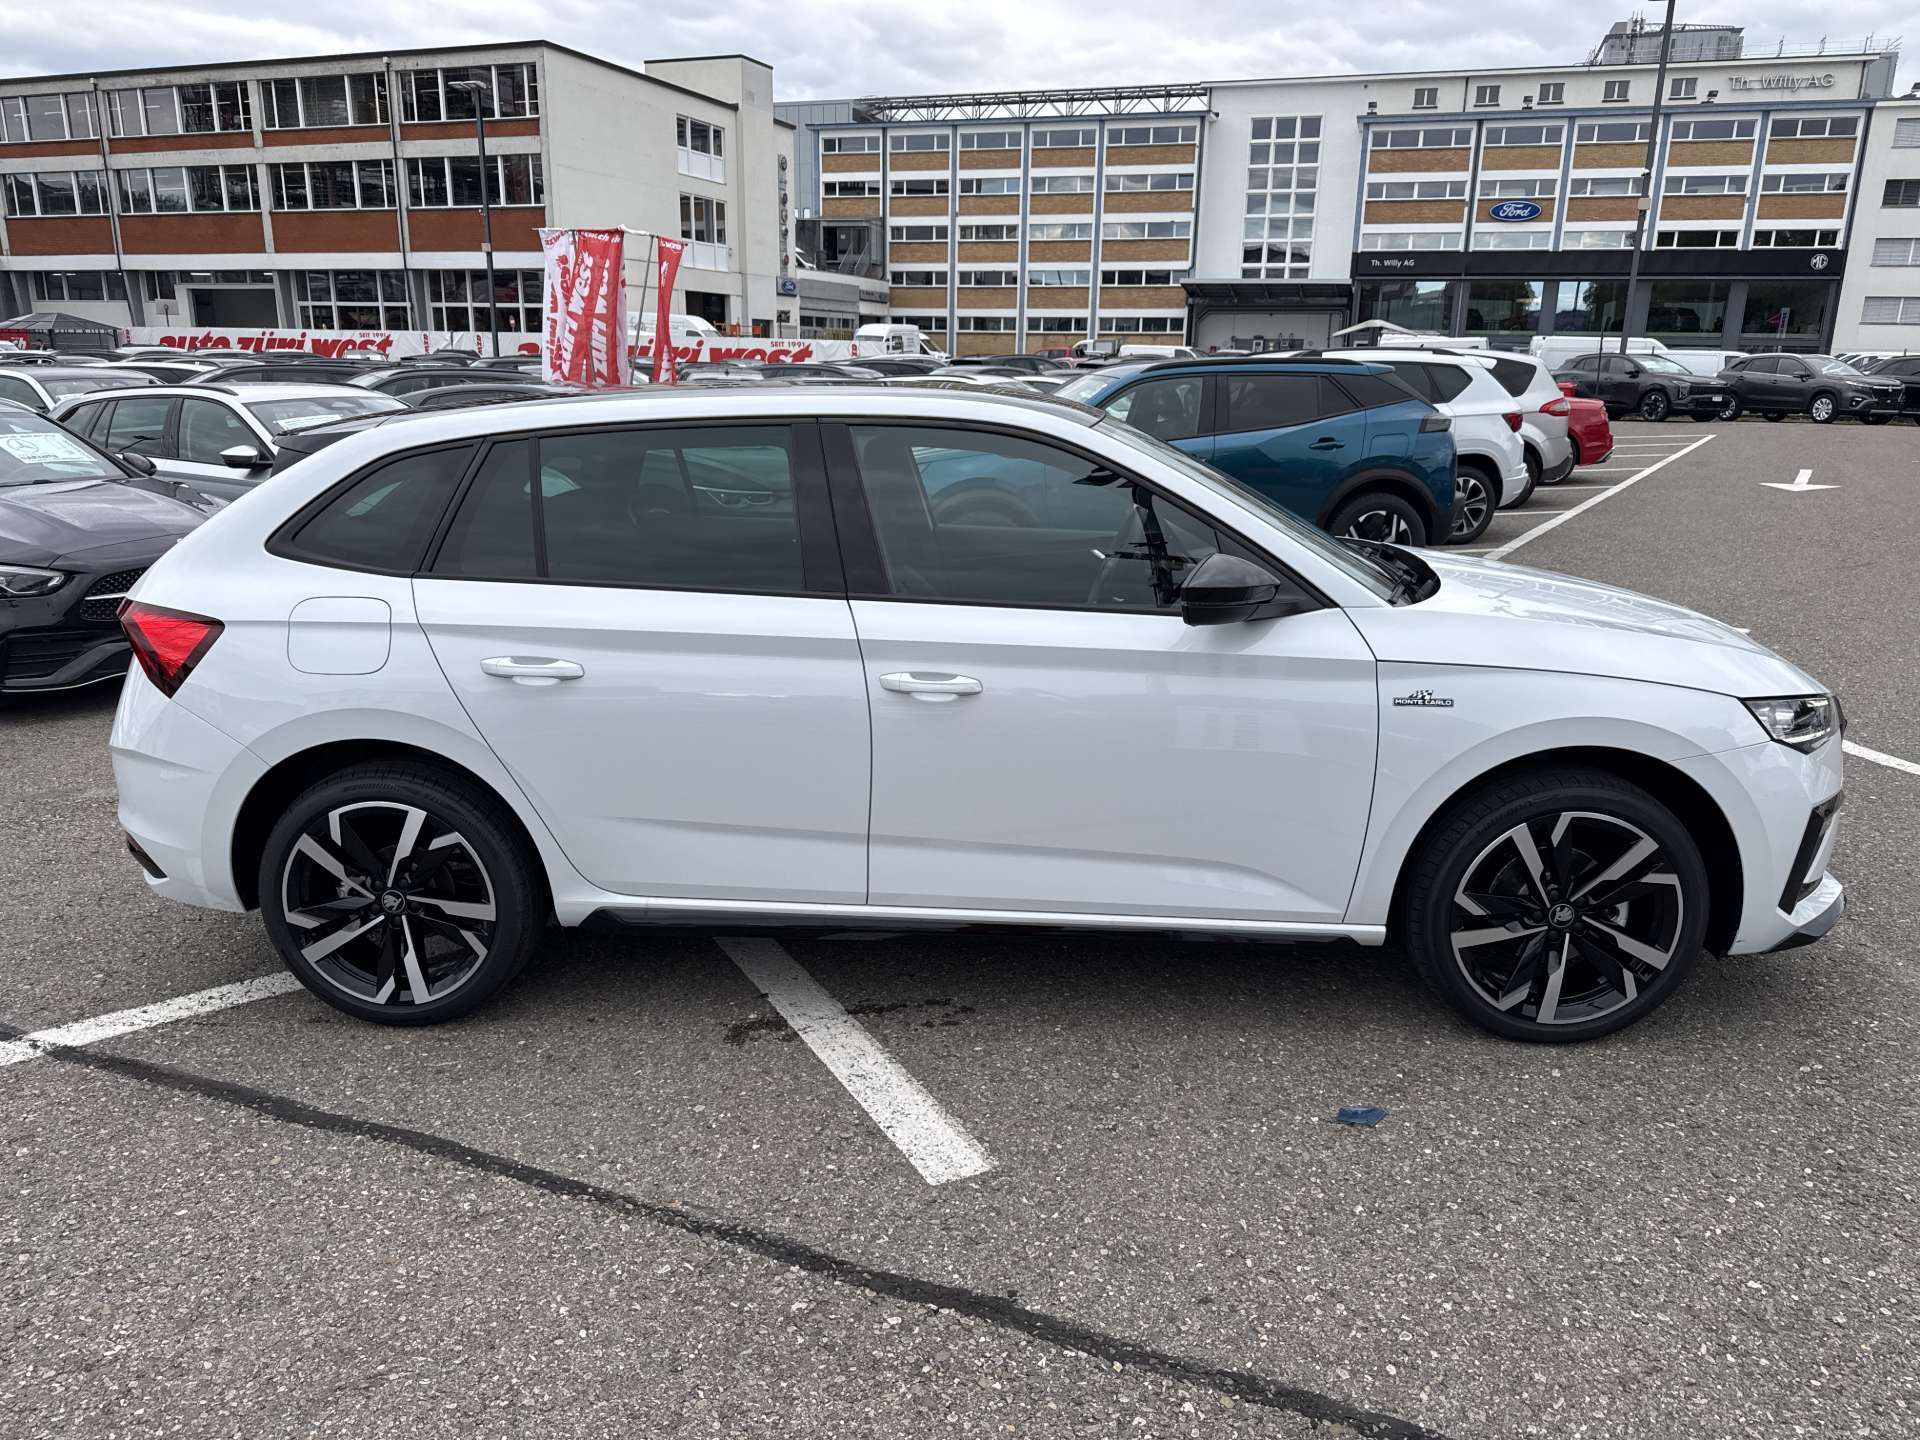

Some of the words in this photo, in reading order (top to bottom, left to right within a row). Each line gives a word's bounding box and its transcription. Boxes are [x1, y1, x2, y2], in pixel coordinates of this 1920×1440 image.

[1761, 73, 1802, 92] Willy
[1806, 73, 1835, 88] AG
[1499, 203, 1532, 217] Ford
[1371, 259, 1382, 267] Th.
[1383, 259, 1402, 269] Willy
[1811, 254, 1828, 270] MG
[160, 330, 231, 352] auto
[311, 334, 394, 360] west
[709, 342, 814, 364] west
[788, 341, 806, 349] 1991
